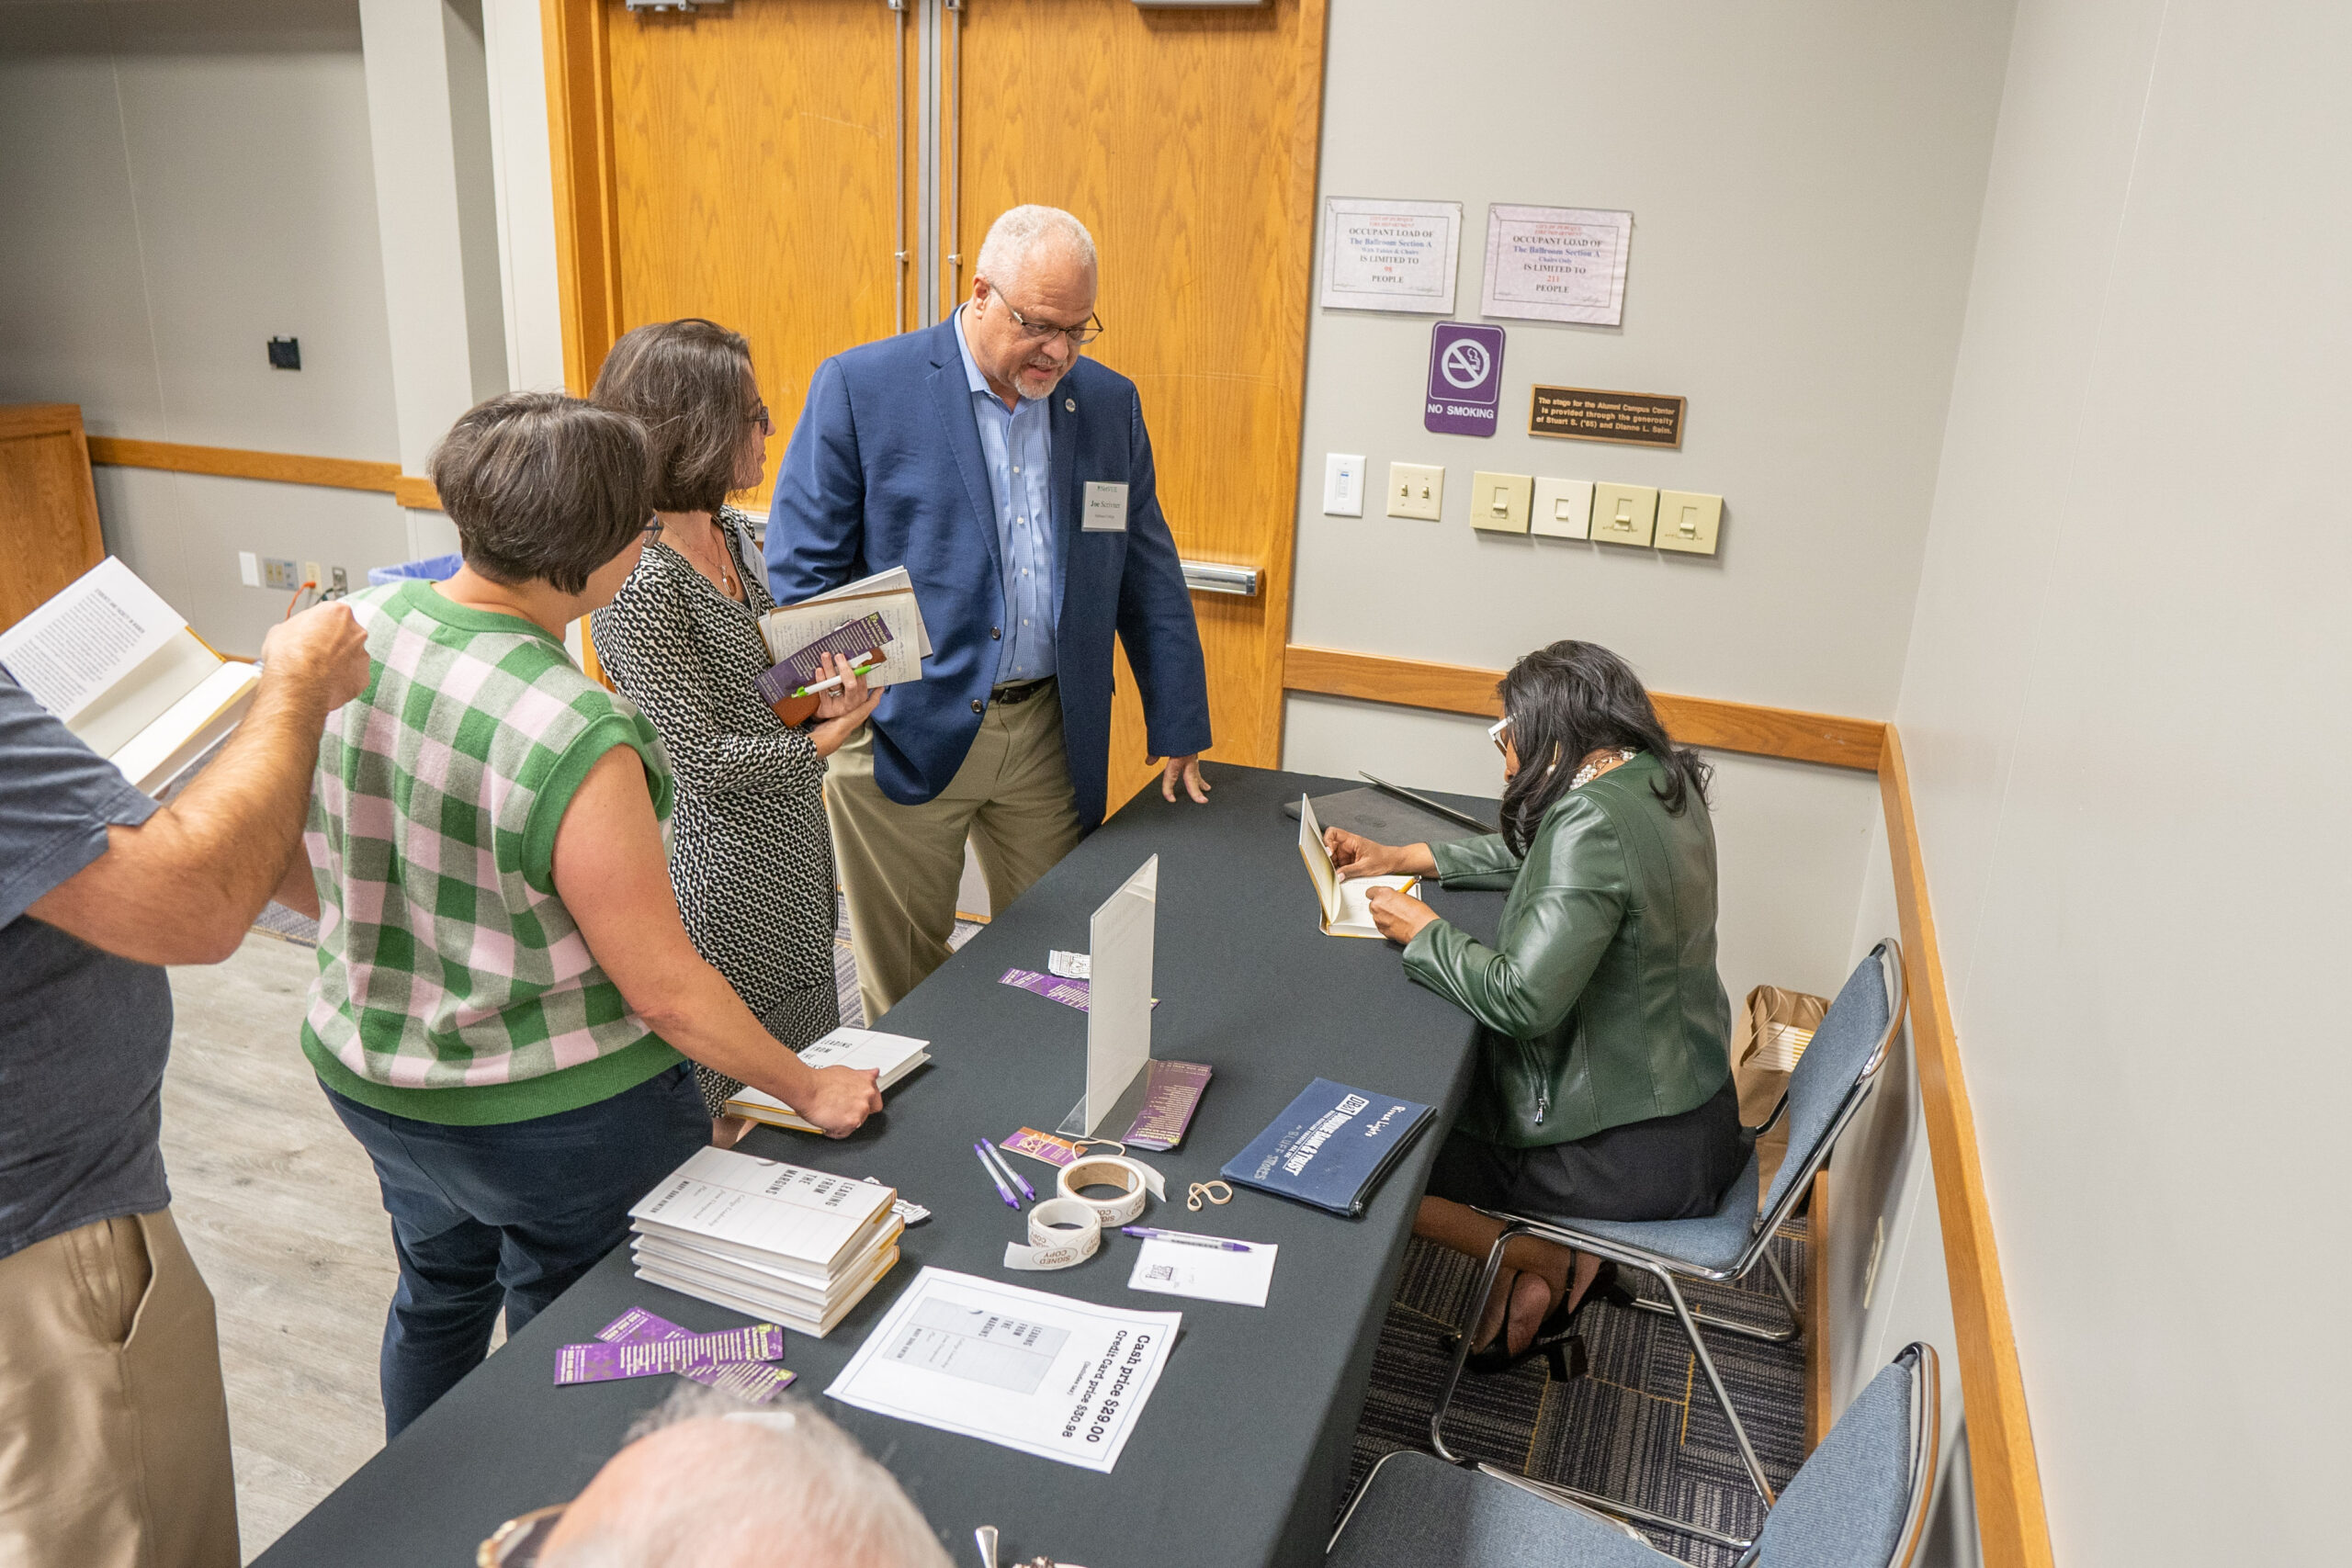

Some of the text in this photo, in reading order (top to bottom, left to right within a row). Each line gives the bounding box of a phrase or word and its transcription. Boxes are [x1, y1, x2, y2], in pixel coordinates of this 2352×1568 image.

[1349, 228, 1395, 236] OCCUPANT
[1396, 229, 1420, 237] LOAD
[1365, 238, 1396, 246] Ballroom
[1398, 240, 1425, 248] Section
[1512, 235, 1561, 245] OCCUPANT
[1563, 237, 1589, 246] LOAD
[1530, 246, 1563, 254] Ballroom
[1566, 248, 1592, 257] Section
[1369, 255, 1406, 264] LIMITED
[1534, 264, 1572, 273] LIMITED
[1372, 275, 1405, 284] PEOPLE
[1535, 284, 1569, 293] PEOPLE
[1427, 403, 1494, 419] NO SMOKING
[1538, 396, 1551, 404] The
[1552, 399, 1571, 407] stage
[1584, 400, 1596, 409] the
[1597, 401, 1621, 411] Alumni
[1623, 403, 1650, 413] Campus
[1652, 406, 1675, 415] Center
[1541, 406, 1673, 426] is provided through the generosity
[1546, 416, 1568, 425] Stuart
[1570, 418, 1578, 426] S.
[1600, 422, 1613, 430] and
[1091, 500, 1101, 508] Joe
[809, 1045, 832, 1054] FROM
[820, 1039, 853, 1048] LEADING
[1340, 1096, 1365, 1113] DB&T
[1275, 1131, 1299, 1153] BLUFF
[1284, 1151, 1314, 1176] TRUST
[676, 1180, 690, 1190] MARY
[765, 1168, 798, 1195] MARGINS
[798, 1173, 818, 1185] THE
[813, 1177, 837, 1194] FROM
[825, 1182, 855, 1207] LEADING
[650, 1199, 669, 1213] HINTON
[1039, 1255, 1071, 1265] SIGNED
[1044, 1249, 1068, 1258] COPY
[978, 1316, 1000, 1337] MARGINS
[1001, 1320, 1014, 1330] THE
[1012, 1323, 1029, 1337] FROM
[1023, 1325, 1043, 1347] LEADING
[1062, 1330, 1127, 1438] Credit Card price $30.98
[1086, 1335, 1150, 1443] Cash price $29.00
